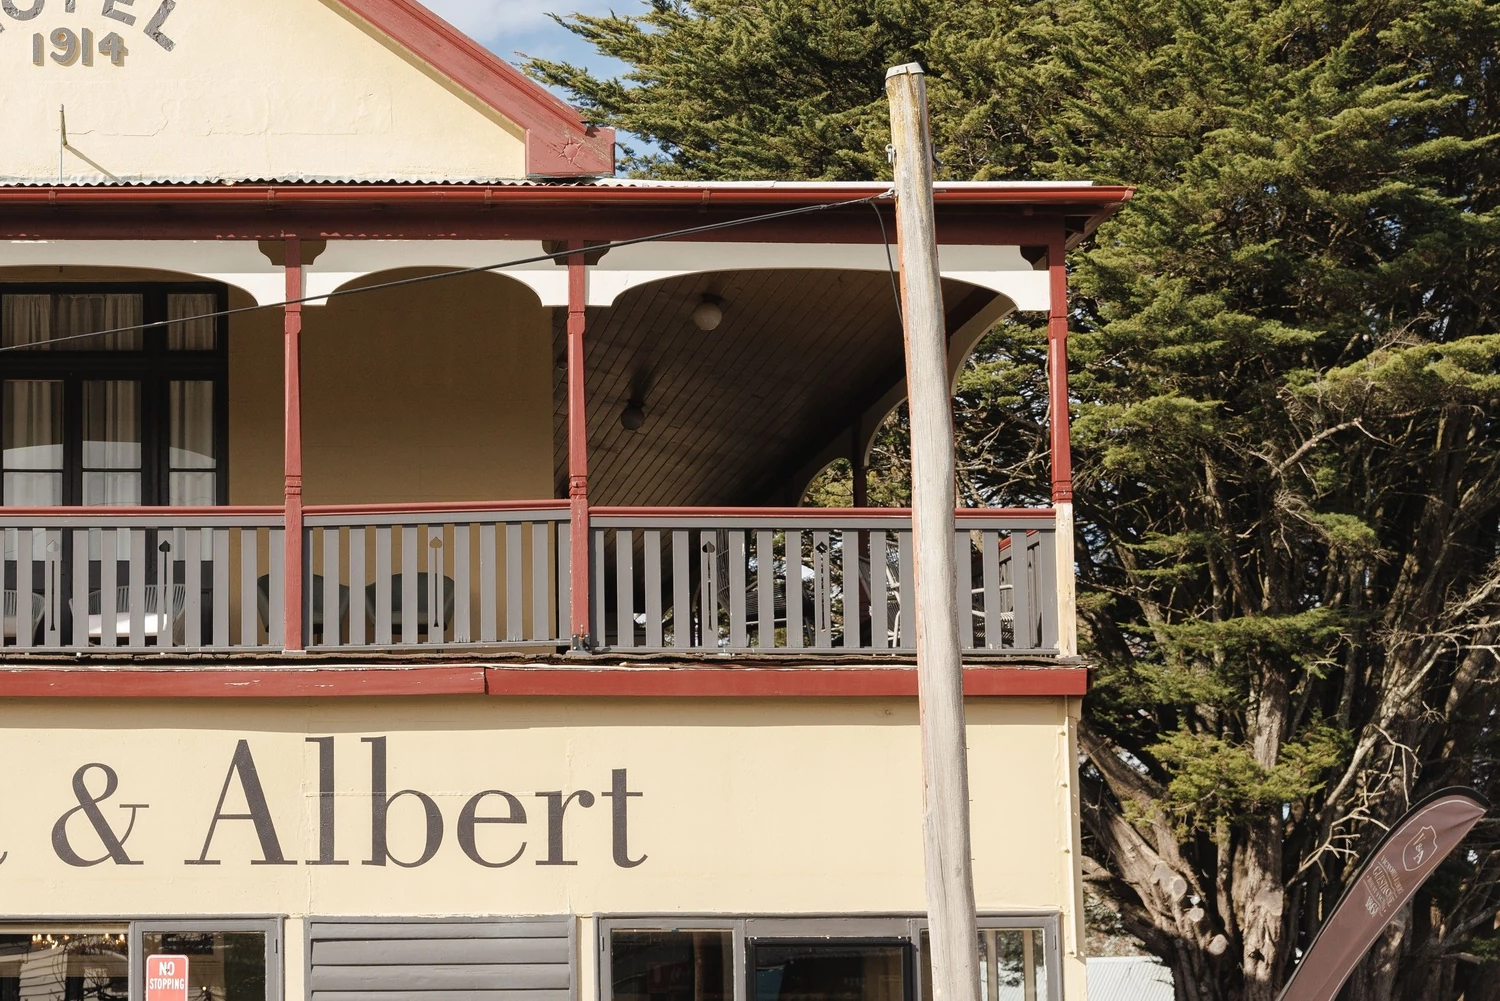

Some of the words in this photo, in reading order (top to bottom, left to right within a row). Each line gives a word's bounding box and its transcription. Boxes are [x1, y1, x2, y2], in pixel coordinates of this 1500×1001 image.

[32, 27, 129, 67] 1914
[51, 762, 150, 868] &
[183, 735, 649, 869] Albert
[159, 961, 175, 976] NO
[149, 978, 185, 990] STOPPING
